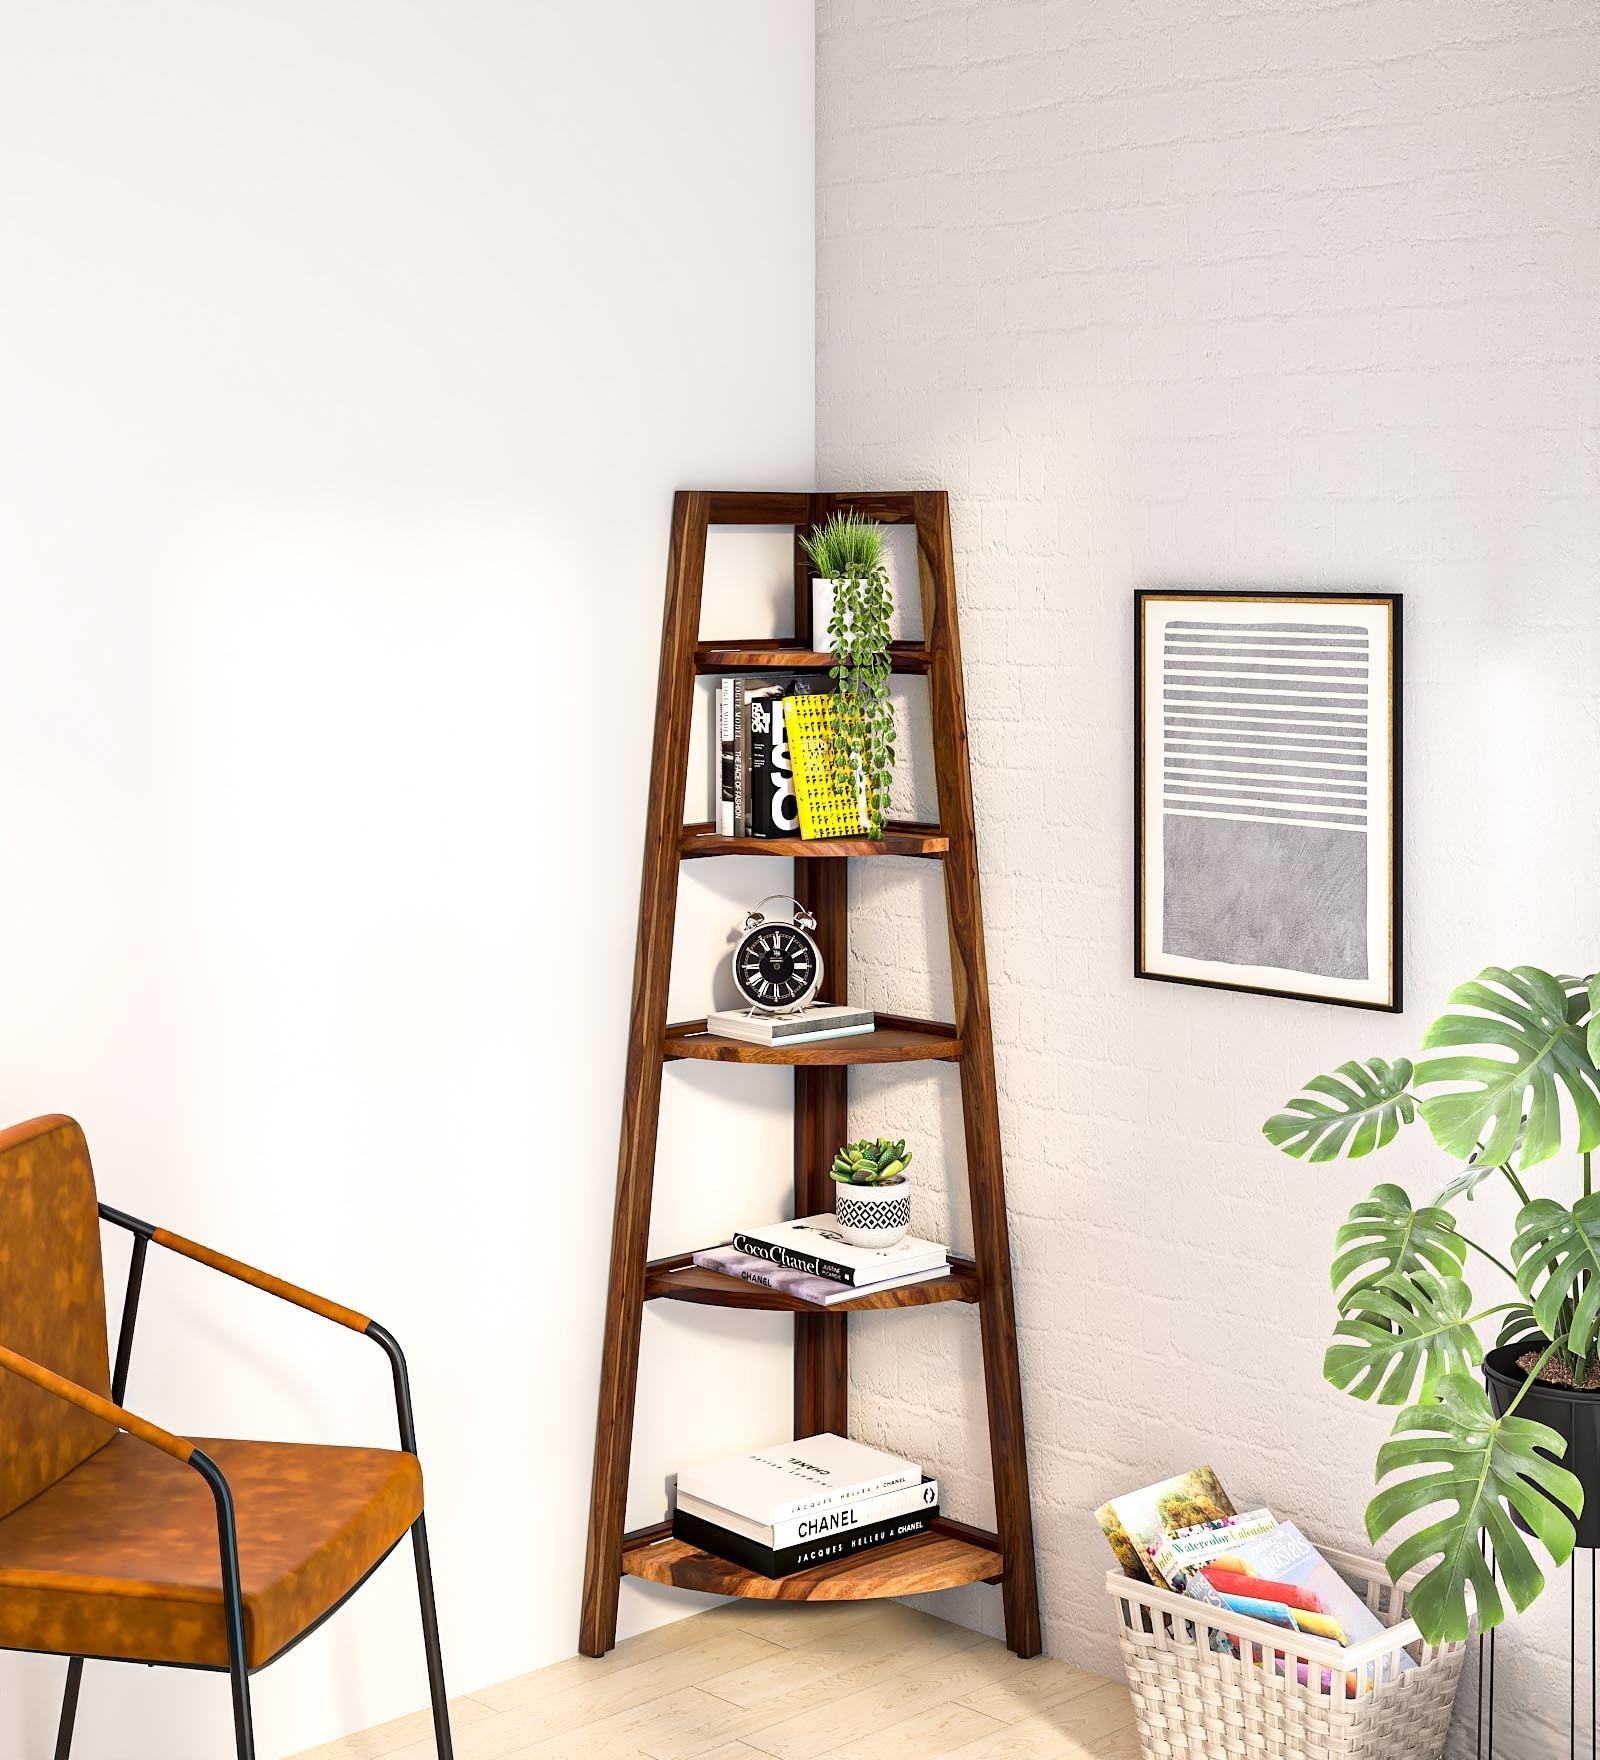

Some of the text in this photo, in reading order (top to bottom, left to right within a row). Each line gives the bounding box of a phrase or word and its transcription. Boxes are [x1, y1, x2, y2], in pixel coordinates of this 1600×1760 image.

[735, 781, 742, 790] OF
[733, 1235, 820, 1276] Coco Chanel
[741, 1271, 772, 1287] CHANEL
[787, 1457, 831, 1476] CHANEL
[883, 1477, 906, 1488] CHANEL
[798, 1509, 858, 1538] CHANEL
[798, 1544, 843, 1563] JACQUES
[851, 1532, 885, 1548] HELLEU
[897, 1521, 924, 1534] CHANEL
[1172, 1533, 1231, 1555] Watercolor
